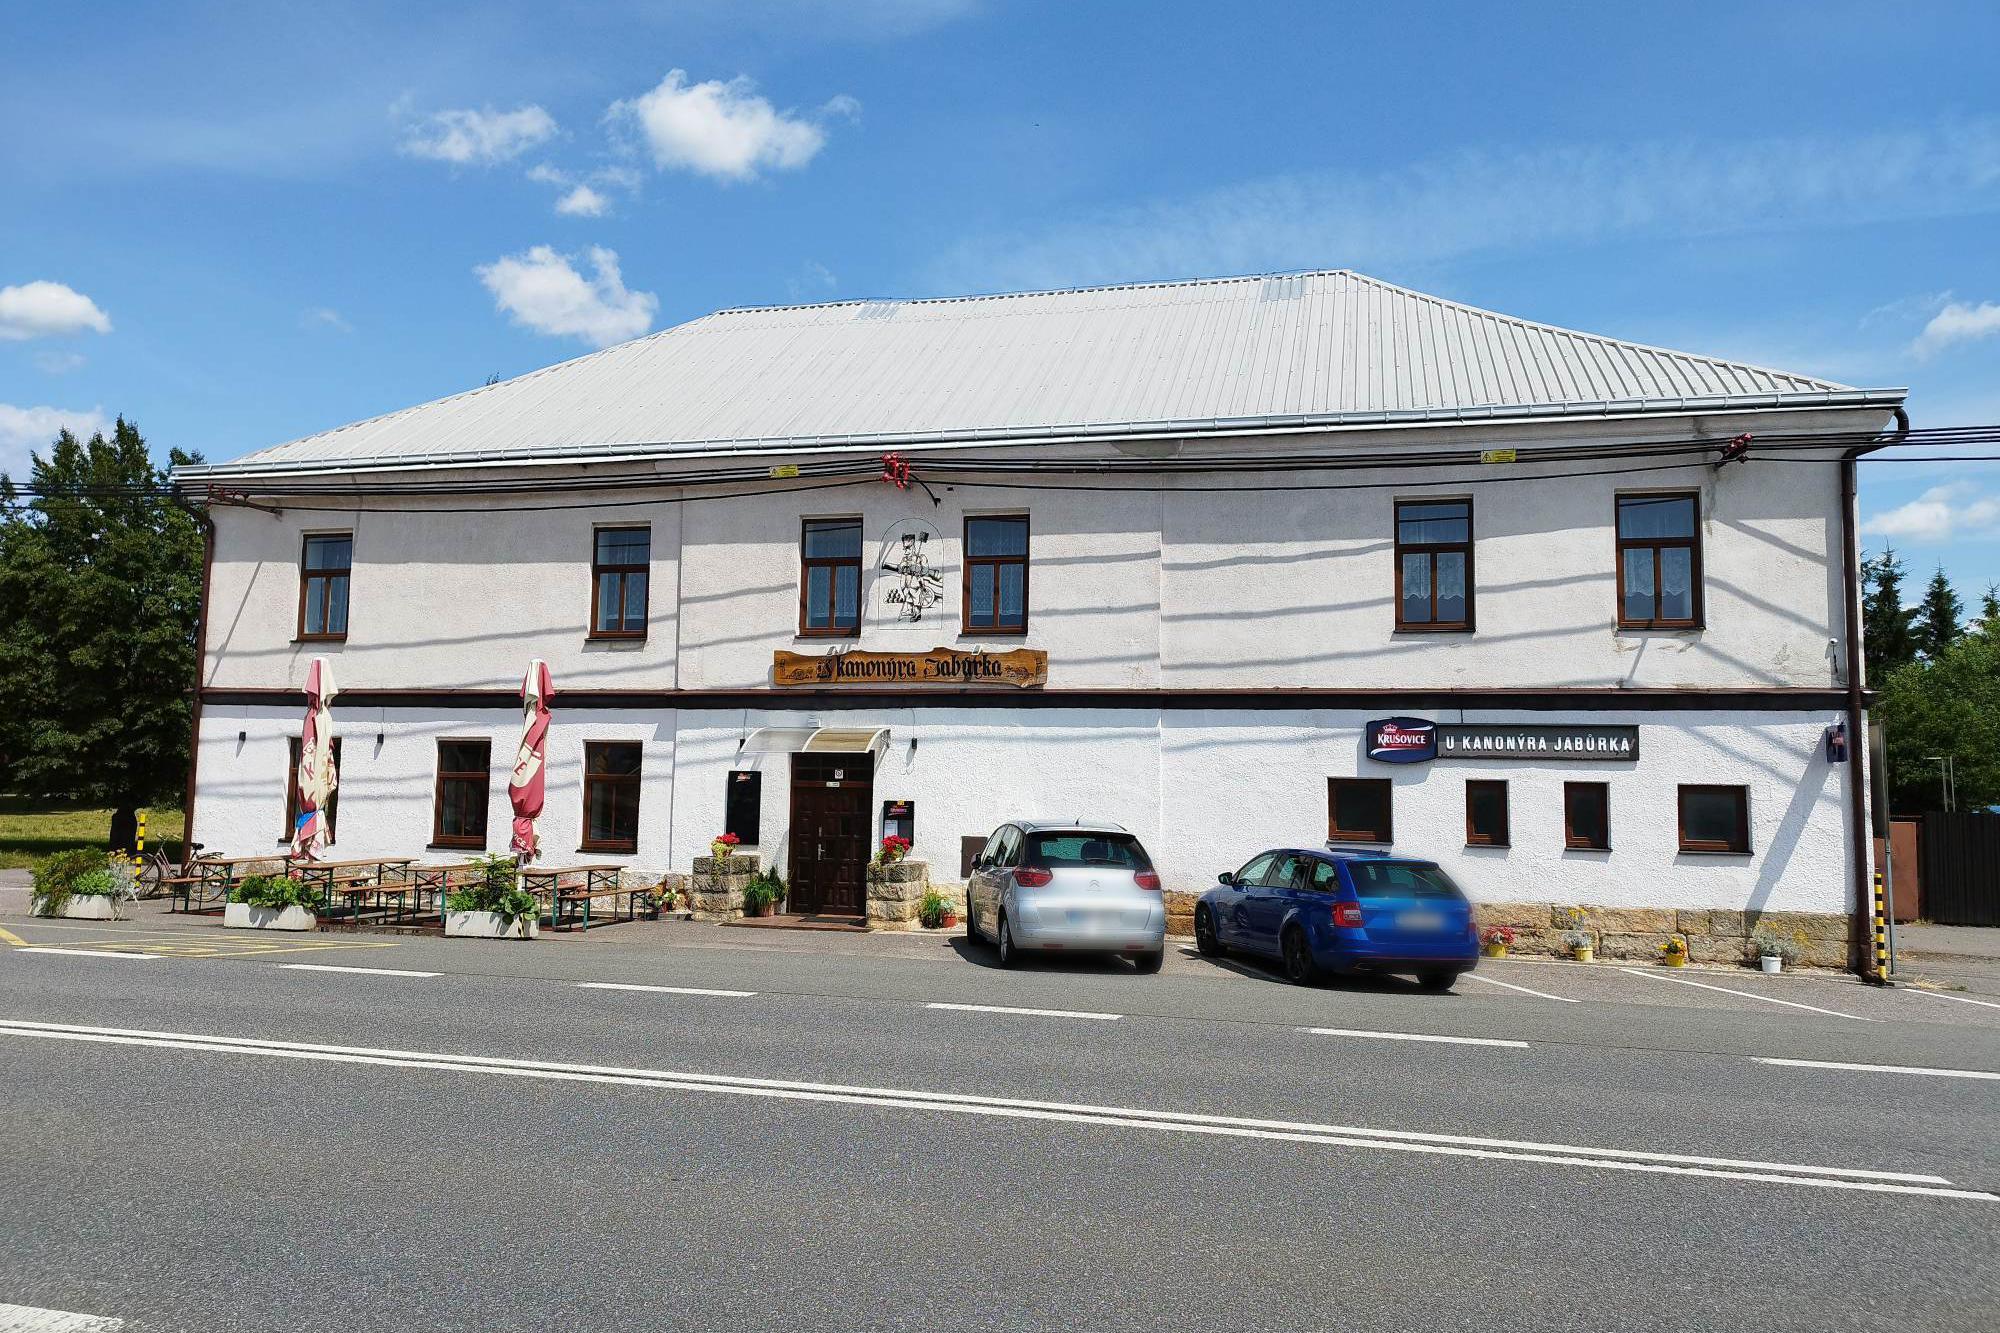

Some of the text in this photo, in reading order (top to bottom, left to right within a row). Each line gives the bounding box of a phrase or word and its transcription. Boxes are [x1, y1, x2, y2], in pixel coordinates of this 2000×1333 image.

[1377, 732, 1427, 747] KRUŠOVICE
[1446, 733, 1630, 751] U KANONÝRA JABŮRKA
